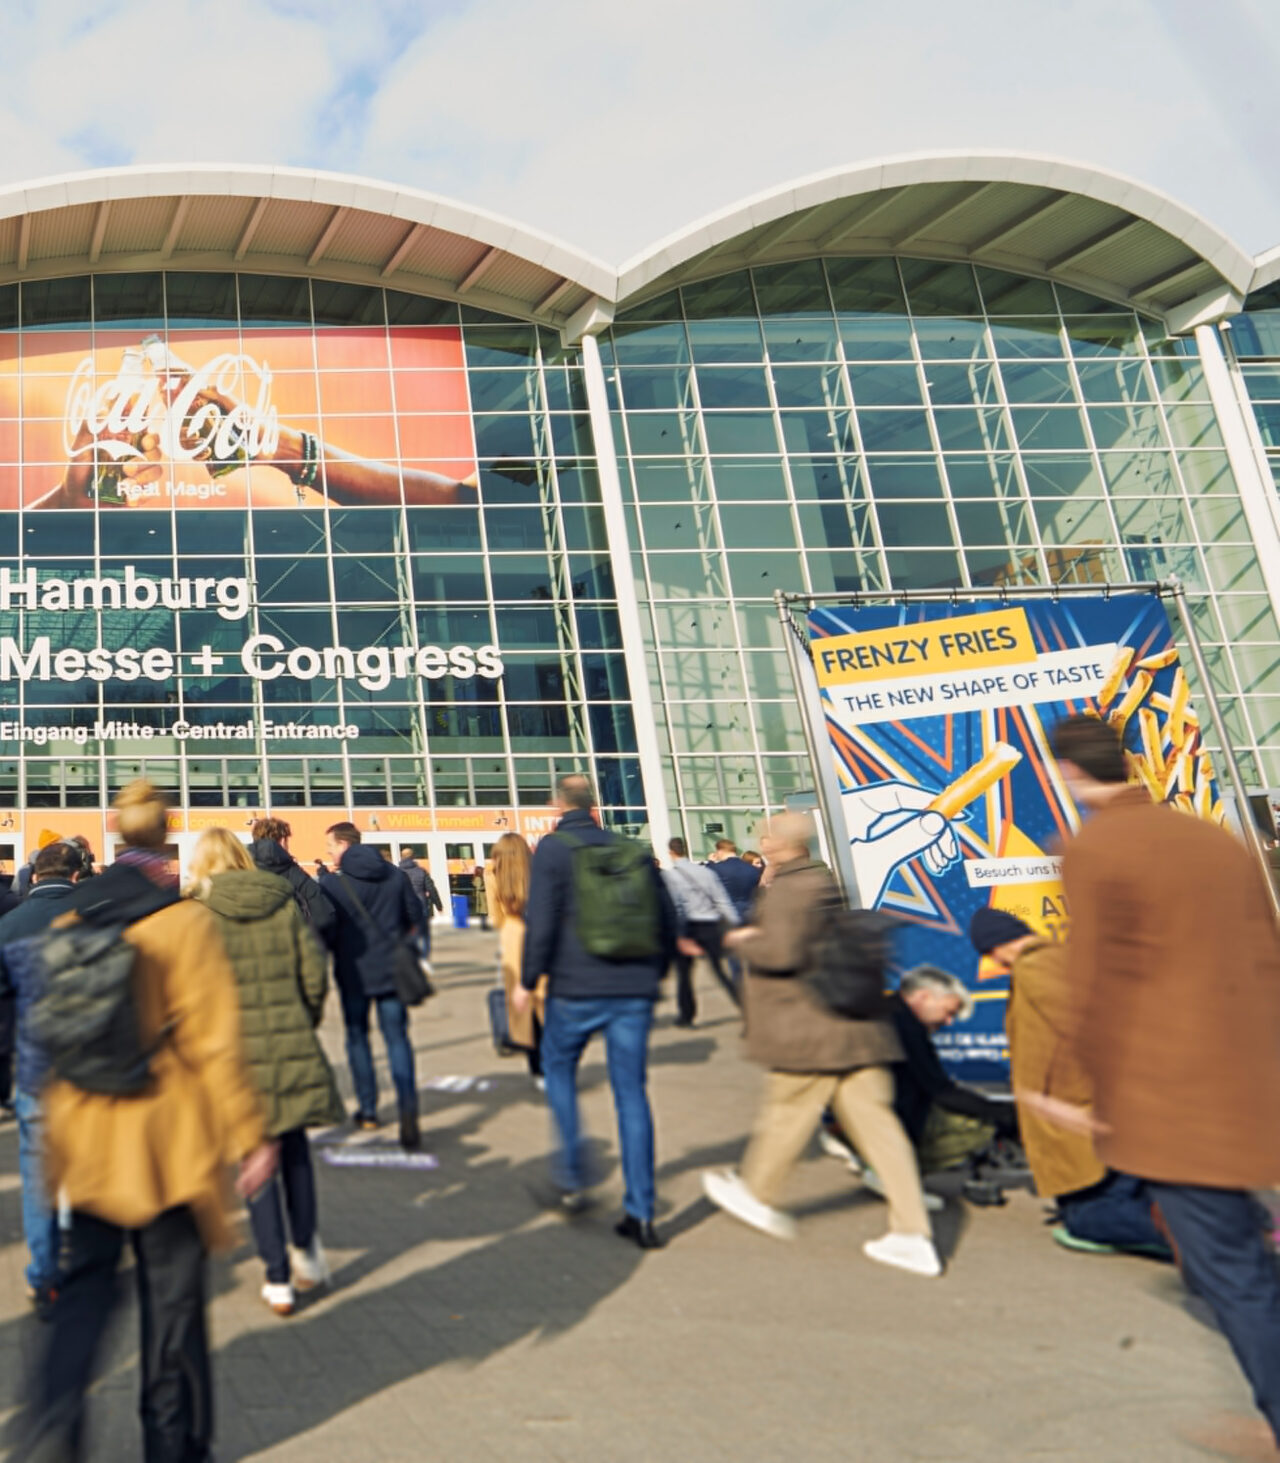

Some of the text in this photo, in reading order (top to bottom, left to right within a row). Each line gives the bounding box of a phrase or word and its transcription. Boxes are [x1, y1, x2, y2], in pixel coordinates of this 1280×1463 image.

[63, 353, 279, 461] Coca-Cola
[116, 481, 227, 498] Real Magic
[0, 565, 249, 620] Hamburg
[0, 634, 505, 691] Messe + Congress
[821, 626, 1018, 674] FRENZY FRIES
[844, 663, 1105, 713] THE NEW SHAPE OF TASTE
[0, 720, 360, 745] Eingang Mitte Central Entrance
[167, 814, 229, 828] elcome
[387, 814, 484, 828] Willkommen!
[974, 864, 1022, 878] Besuch
[1026, 865, 1050, 876] uns
